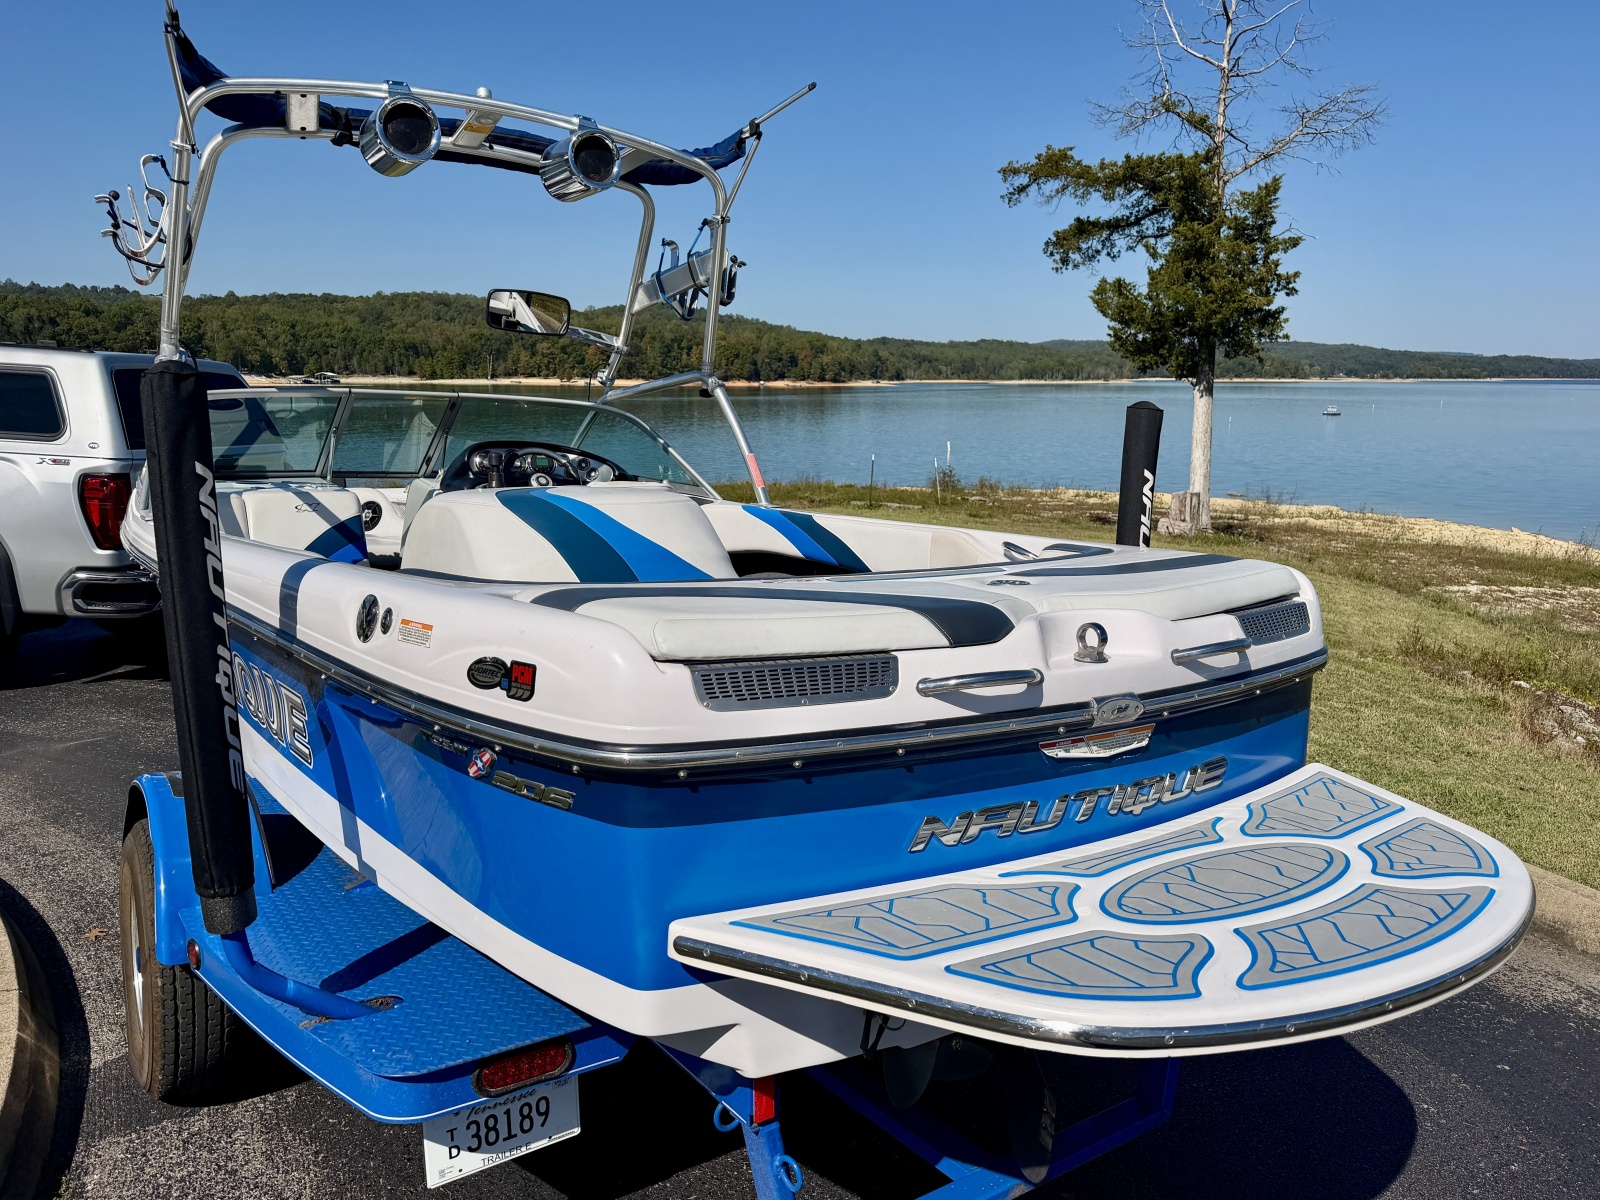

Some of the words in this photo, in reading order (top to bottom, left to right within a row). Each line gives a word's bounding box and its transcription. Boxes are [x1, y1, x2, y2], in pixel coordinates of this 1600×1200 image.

[195, 461, 245, 795] NAUTIQUE
[473, 666, 501, 678] VORTEC
[512, 664, 533, 685] PCM
[492, 770, 576, 811] 206
[908, 755, 1229, 852] NAUTIQUE
[466, 1095, 550, 1153] 38189
[481, 1144, 522, 1167] TRAILER
